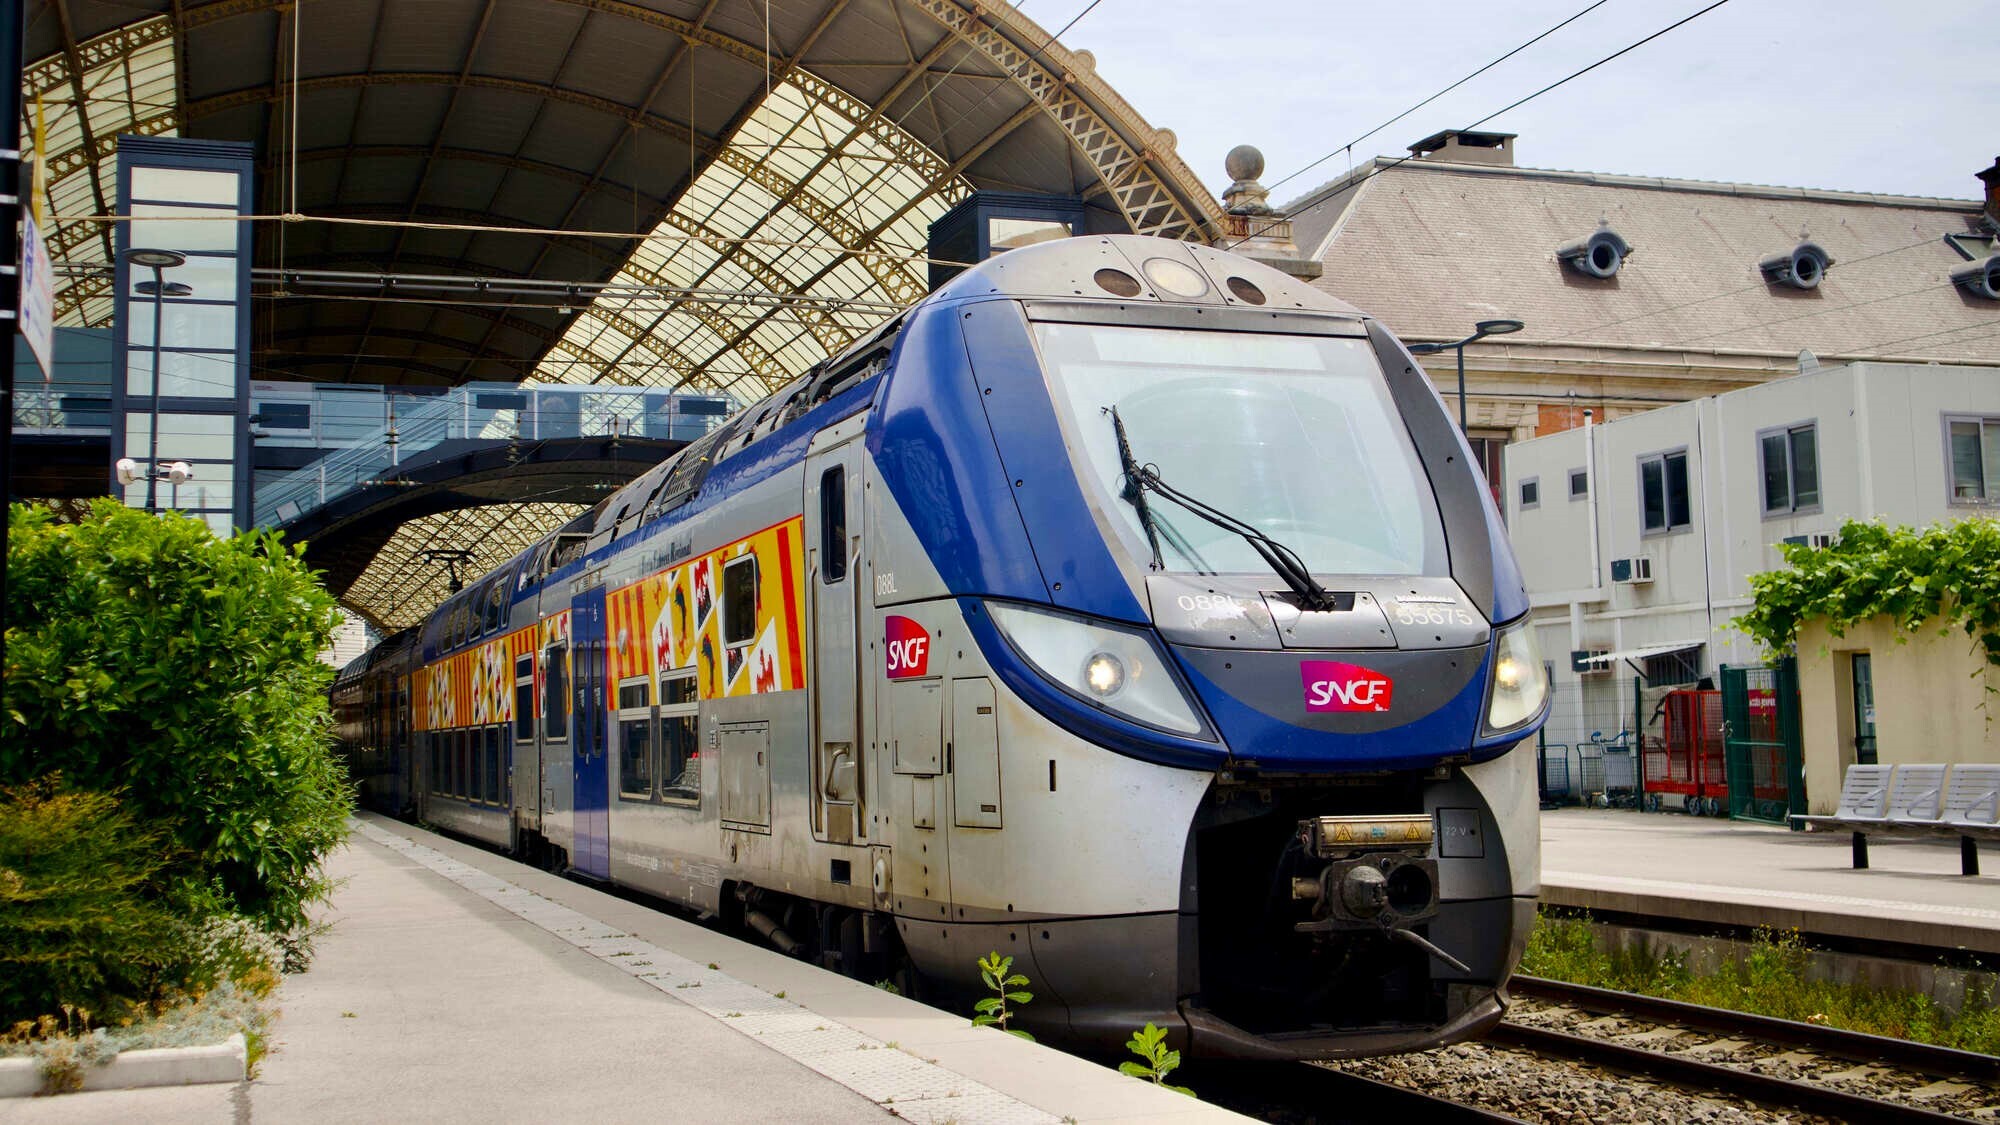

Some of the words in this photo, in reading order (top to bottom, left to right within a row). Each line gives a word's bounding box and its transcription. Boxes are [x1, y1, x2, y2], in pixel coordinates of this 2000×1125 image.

[876, 571, 898, 596] 088L
[1397, 607, 1473, 625] 55675
[888, 637, 927, 671] SNCF
[1309, 679, 1387, 706] SNCF
